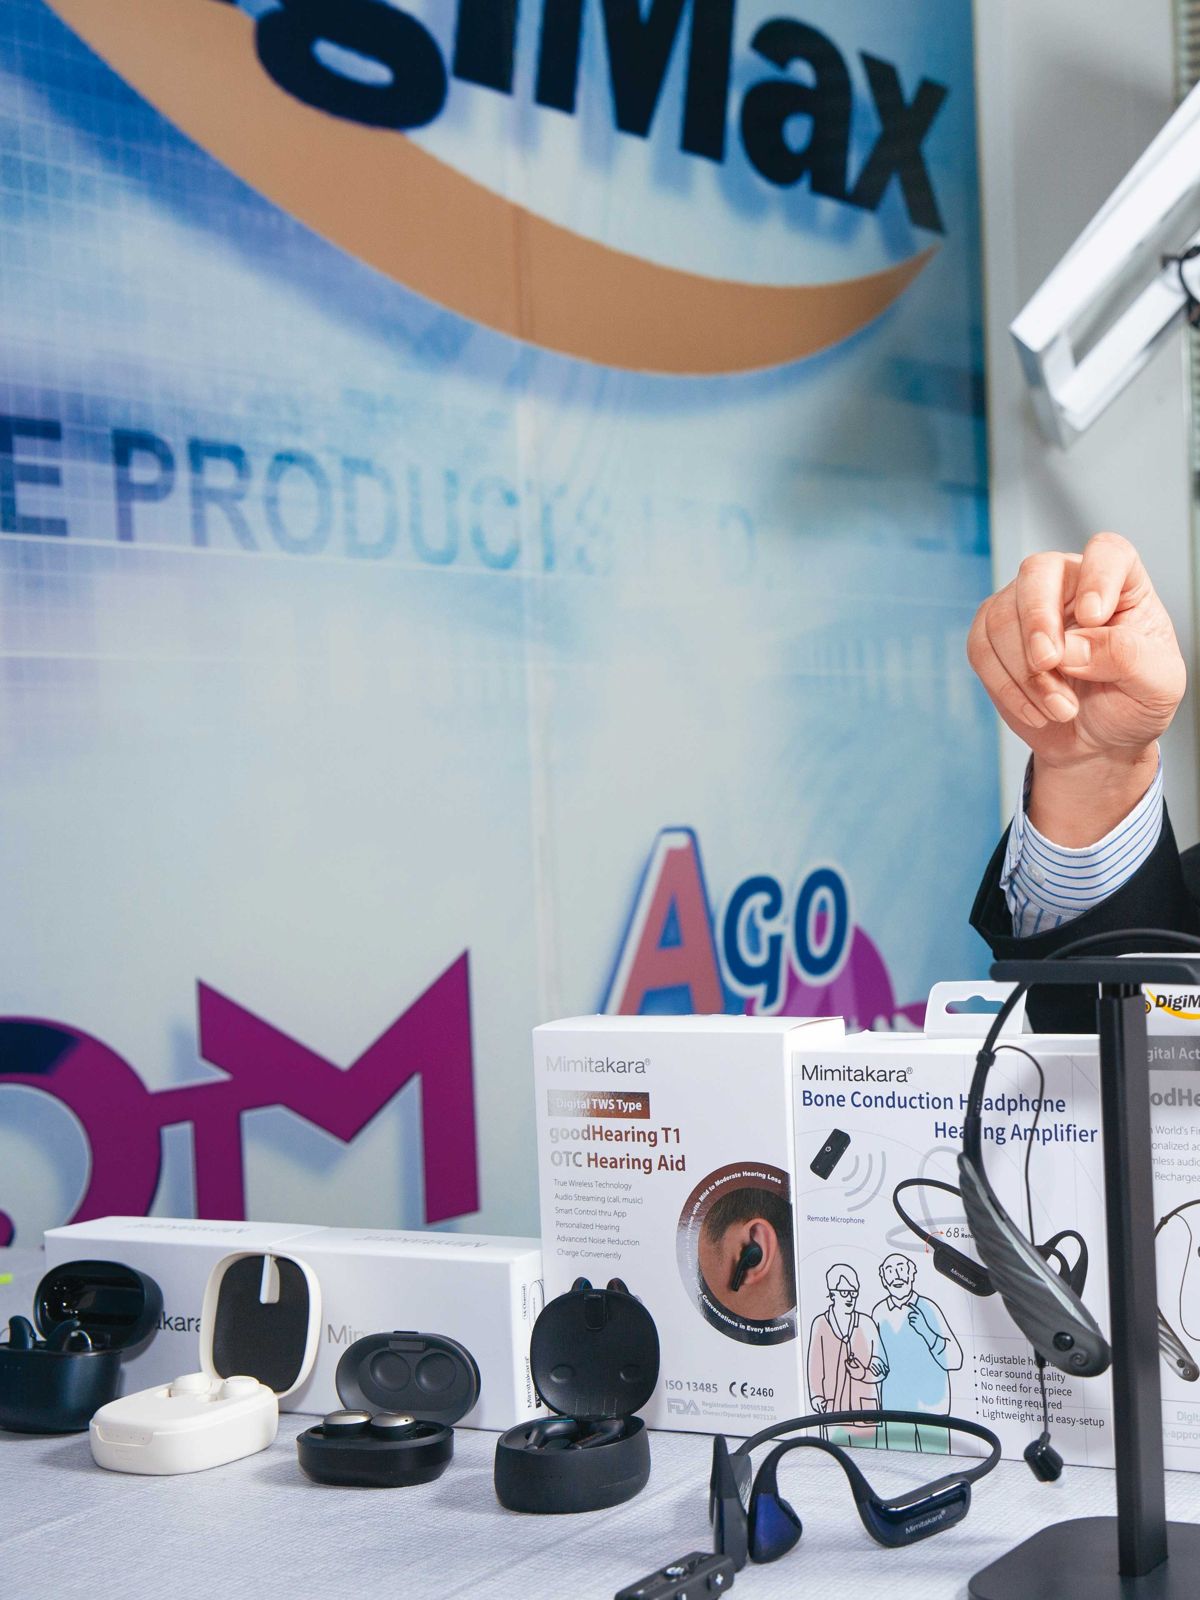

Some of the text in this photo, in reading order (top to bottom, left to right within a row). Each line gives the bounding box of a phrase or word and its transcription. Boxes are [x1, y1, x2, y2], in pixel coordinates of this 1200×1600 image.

[1147, 1047, 1175, 1062] gital
[557, 1098, 642, 1113] Digital TWS Type
[801, 1090, 1066, 1114] Bone Conduction Hadphone
[550, 1124, 680, 1147] goodHearing T1
[935, 1122, 1098, 1144] Heang Amplifier
[1155, 1127, 1189, 1136] World's
[1151, 1142, 1189, 1151] onalized
[550, 1150, 686, 1174] OTC Hearing Aid
[554, 1179, 632, 1191] True Wireless Technology
[714, 1171, 741, 1188] Moderate
[742, 1171, 766, 1180] Hearing
[768, 1174, 782, 1184] Loss
[554, 1193, 573, 1201] Audio
[574, 1194, 605, 1203] Streaming
[555, 1207, 627, 1218] Smart Control thru App
[555, 1220, 620, 1232] Personalized Hearing
[807, 1214, 865, 1226] Remote Microphone
[557, 1235, 640, 1246] Advanced Noise Reduction
[557, 1248, 622, 1260] Charge Conveniently
[702, 1294, 738, 1327] Conversations
[746, 1325, 764, 1334] Every
[765, 1322, 789, 1333] Moment
[980, 1354, 1026, 1366] Adjustable
[980, 1368, 1002, 1378] Clear
[1006, 1370, 1032, 1380] sound
[665, 1380, 683, 1391] ISO
[686, 1381, 718, 1393] 13485
[750, 1386, 774, 1398] 2460
[981, 1382, 993, 1391] No
[996, 1383, 1017, 1393] need
[1019, 1383, 1032, 1394] for
[667, 1398, 700, 1416] FDA
[982, 1395, 1062, 1411] No fitting requred
[982, 1409, 1034, 1423] Lightweight
[1056, 1414, 1105, 1428] easy-setup
